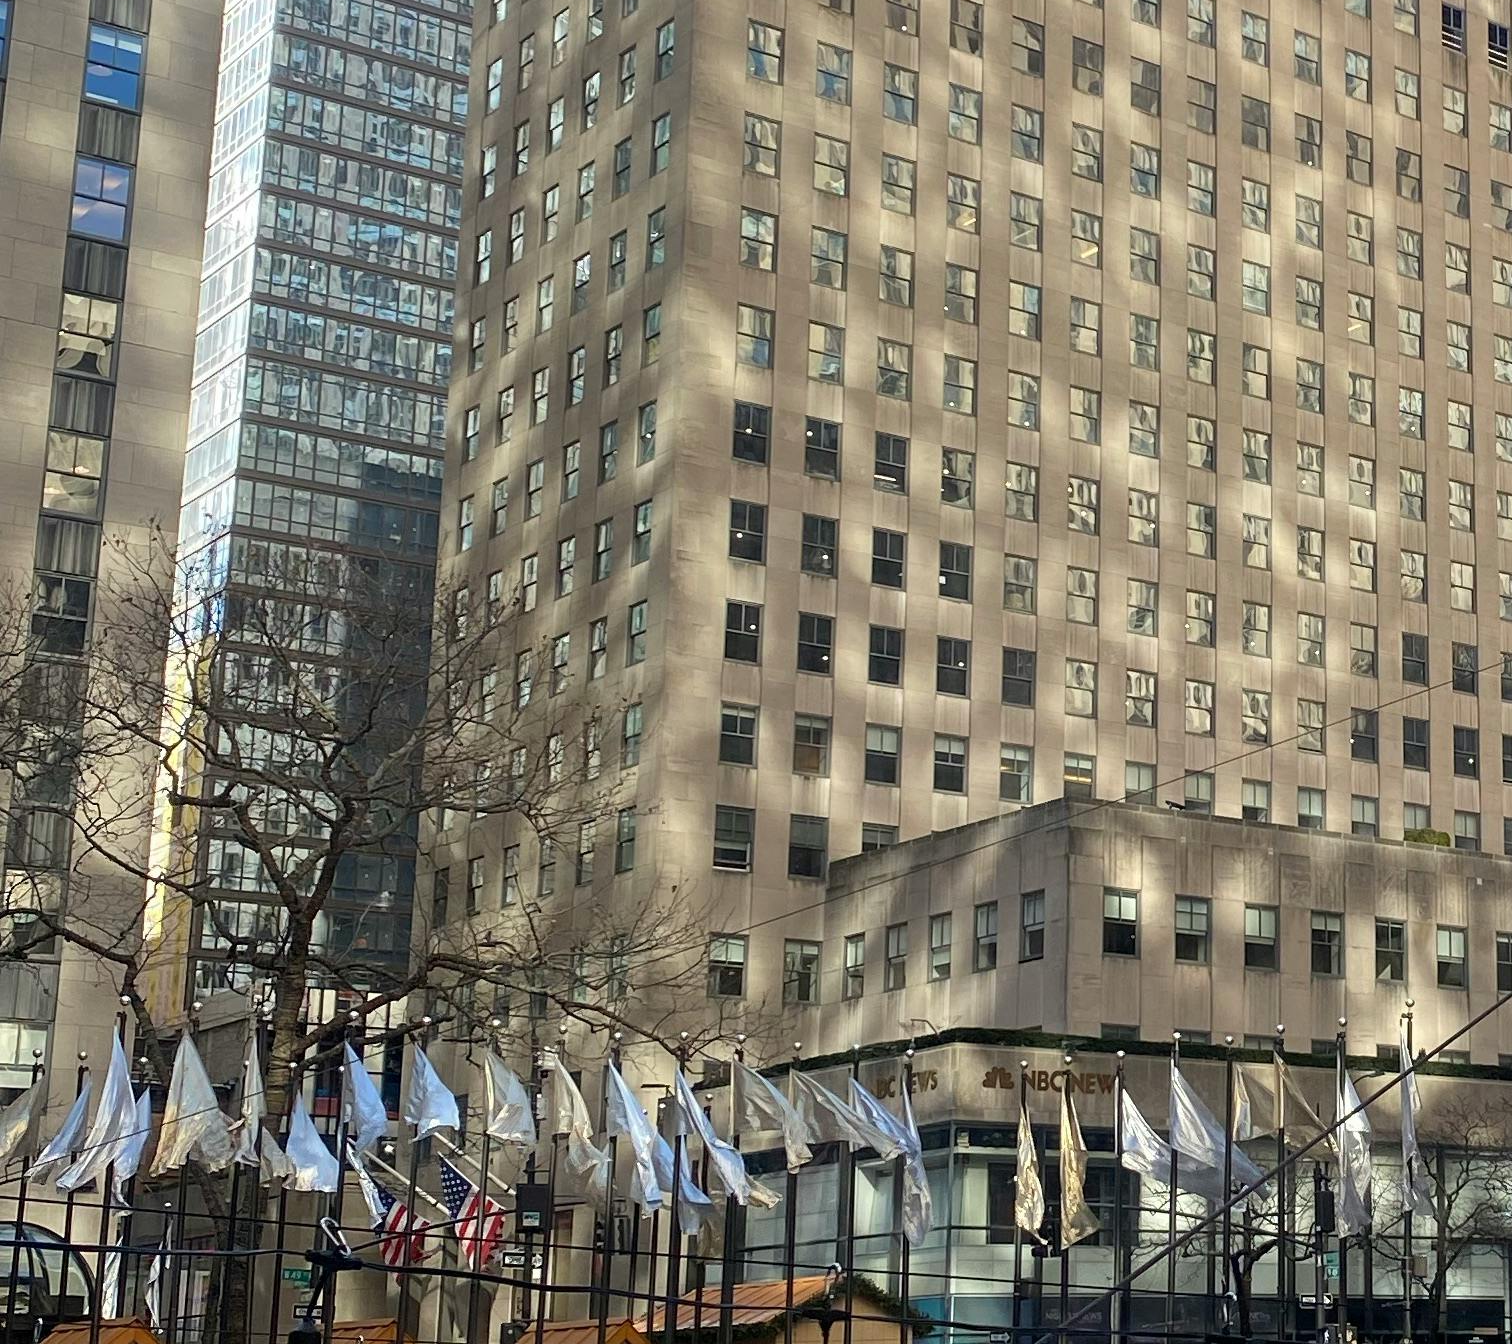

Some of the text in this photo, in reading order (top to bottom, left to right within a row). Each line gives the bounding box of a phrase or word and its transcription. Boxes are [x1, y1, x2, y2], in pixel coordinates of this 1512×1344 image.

[900, 1070, 938, 1097] EWS
[1022, 1070, 1115, 1094] NBC NEW
